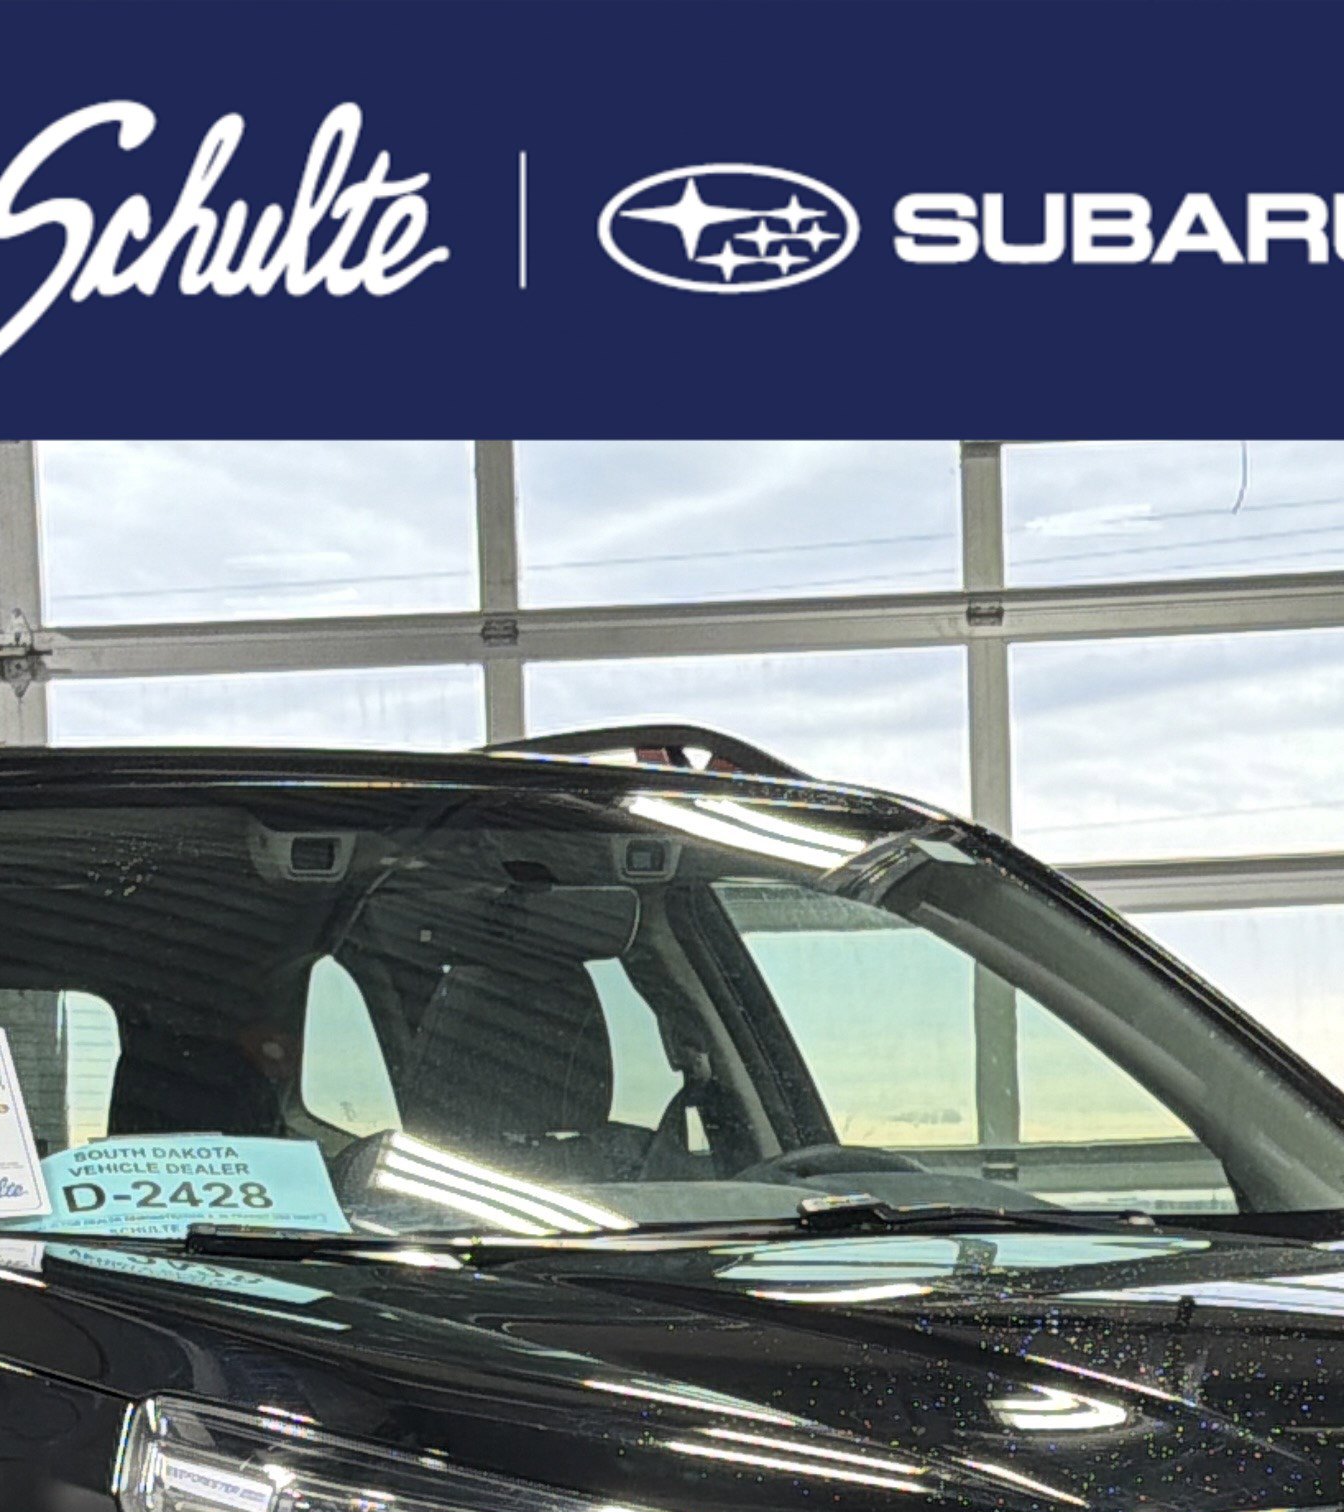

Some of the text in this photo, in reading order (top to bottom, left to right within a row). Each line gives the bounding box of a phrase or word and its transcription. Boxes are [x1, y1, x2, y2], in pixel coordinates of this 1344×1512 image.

[74, 1146, 239, 1162] SOUTH DAKOTA
[69, 1162, 249, 1177] VEHICLE DEALER
[62, 1180, 273, 1213] D-2428
